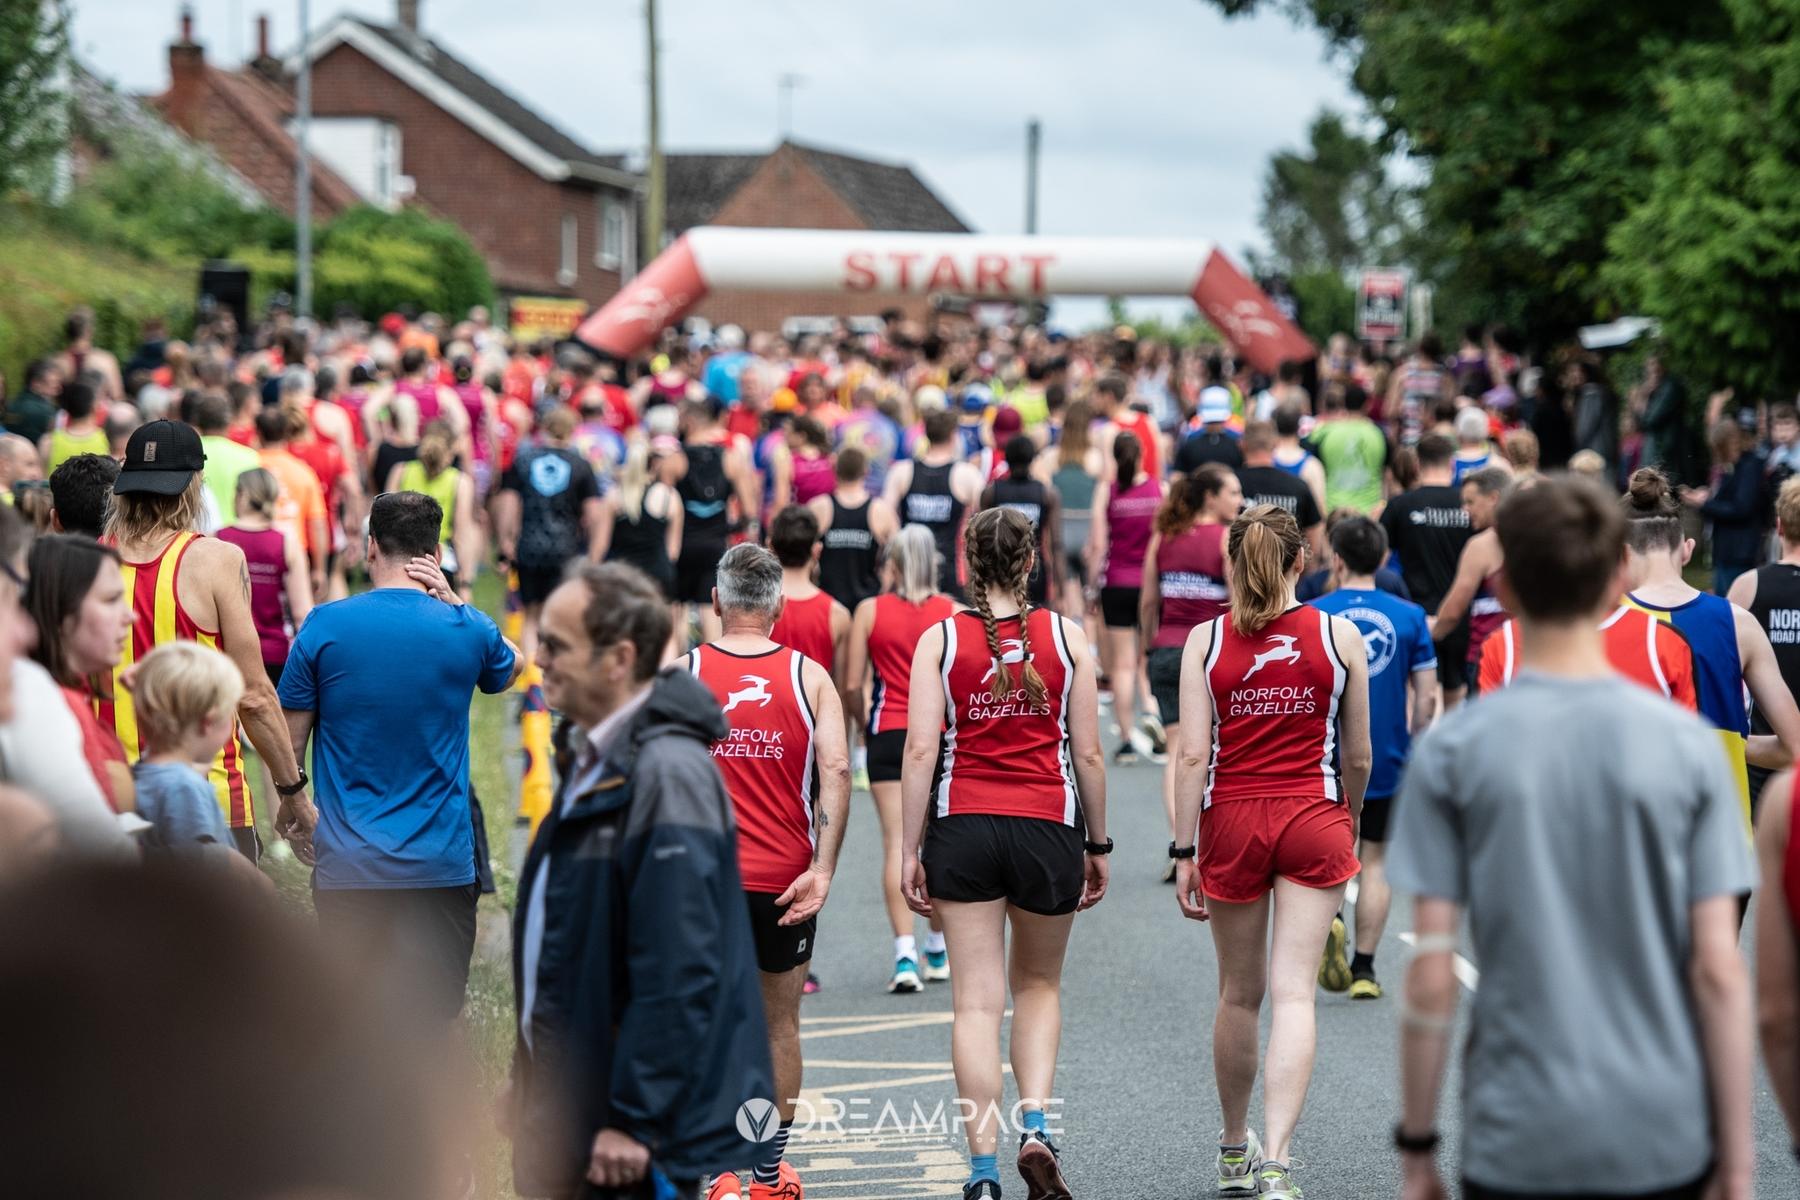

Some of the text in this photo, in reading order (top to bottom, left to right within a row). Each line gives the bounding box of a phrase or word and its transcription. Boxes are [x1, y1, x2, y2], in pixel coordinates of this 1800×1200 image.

[845, 250, 1055, 293] START
[969, 688, 1048, 706] NORFOK
[1230, 686, 1315, 702] NORFOLK
[968, 703, 1050, 720] GAZELLES
[1230, 701, 1316, 716] GAZELLES
[717, 728, 783, 744] RFOLK
